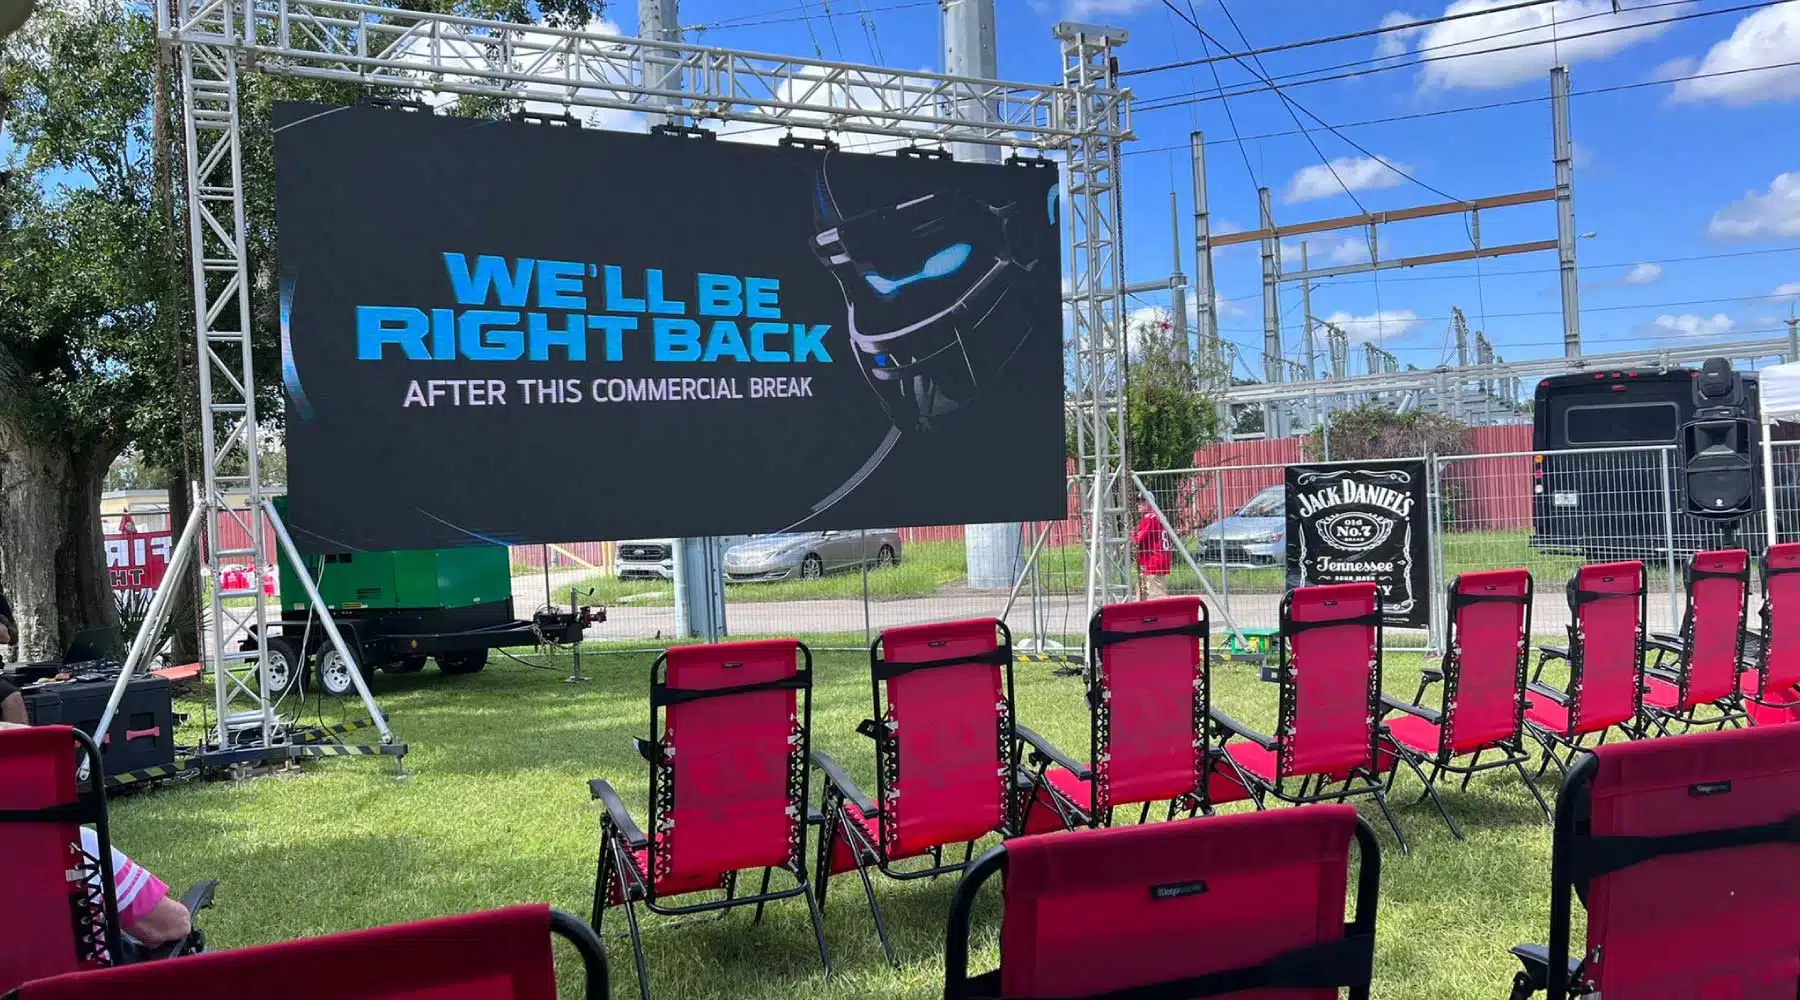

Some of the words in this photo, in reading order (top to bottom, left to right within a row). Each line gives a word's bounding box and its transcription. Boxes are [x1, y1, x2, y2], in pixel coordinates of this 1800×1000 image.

[442, 251, 685, 315] WE'LL
[696, 272, 782, 319] BE
[356, 305, 638, 361] RIGHT
[653, 318, 833, 363] BACK
[403, 379, 506, 408] AFTER
[516, 379, 582, 405] THIS
[592, 378, 743, 402] COMMERCIAL
[750, 376, 813, 399] BREAK
[1297, 485, 1341, 517] JACK
[1316, 556, 1394, 572] Tennessee
